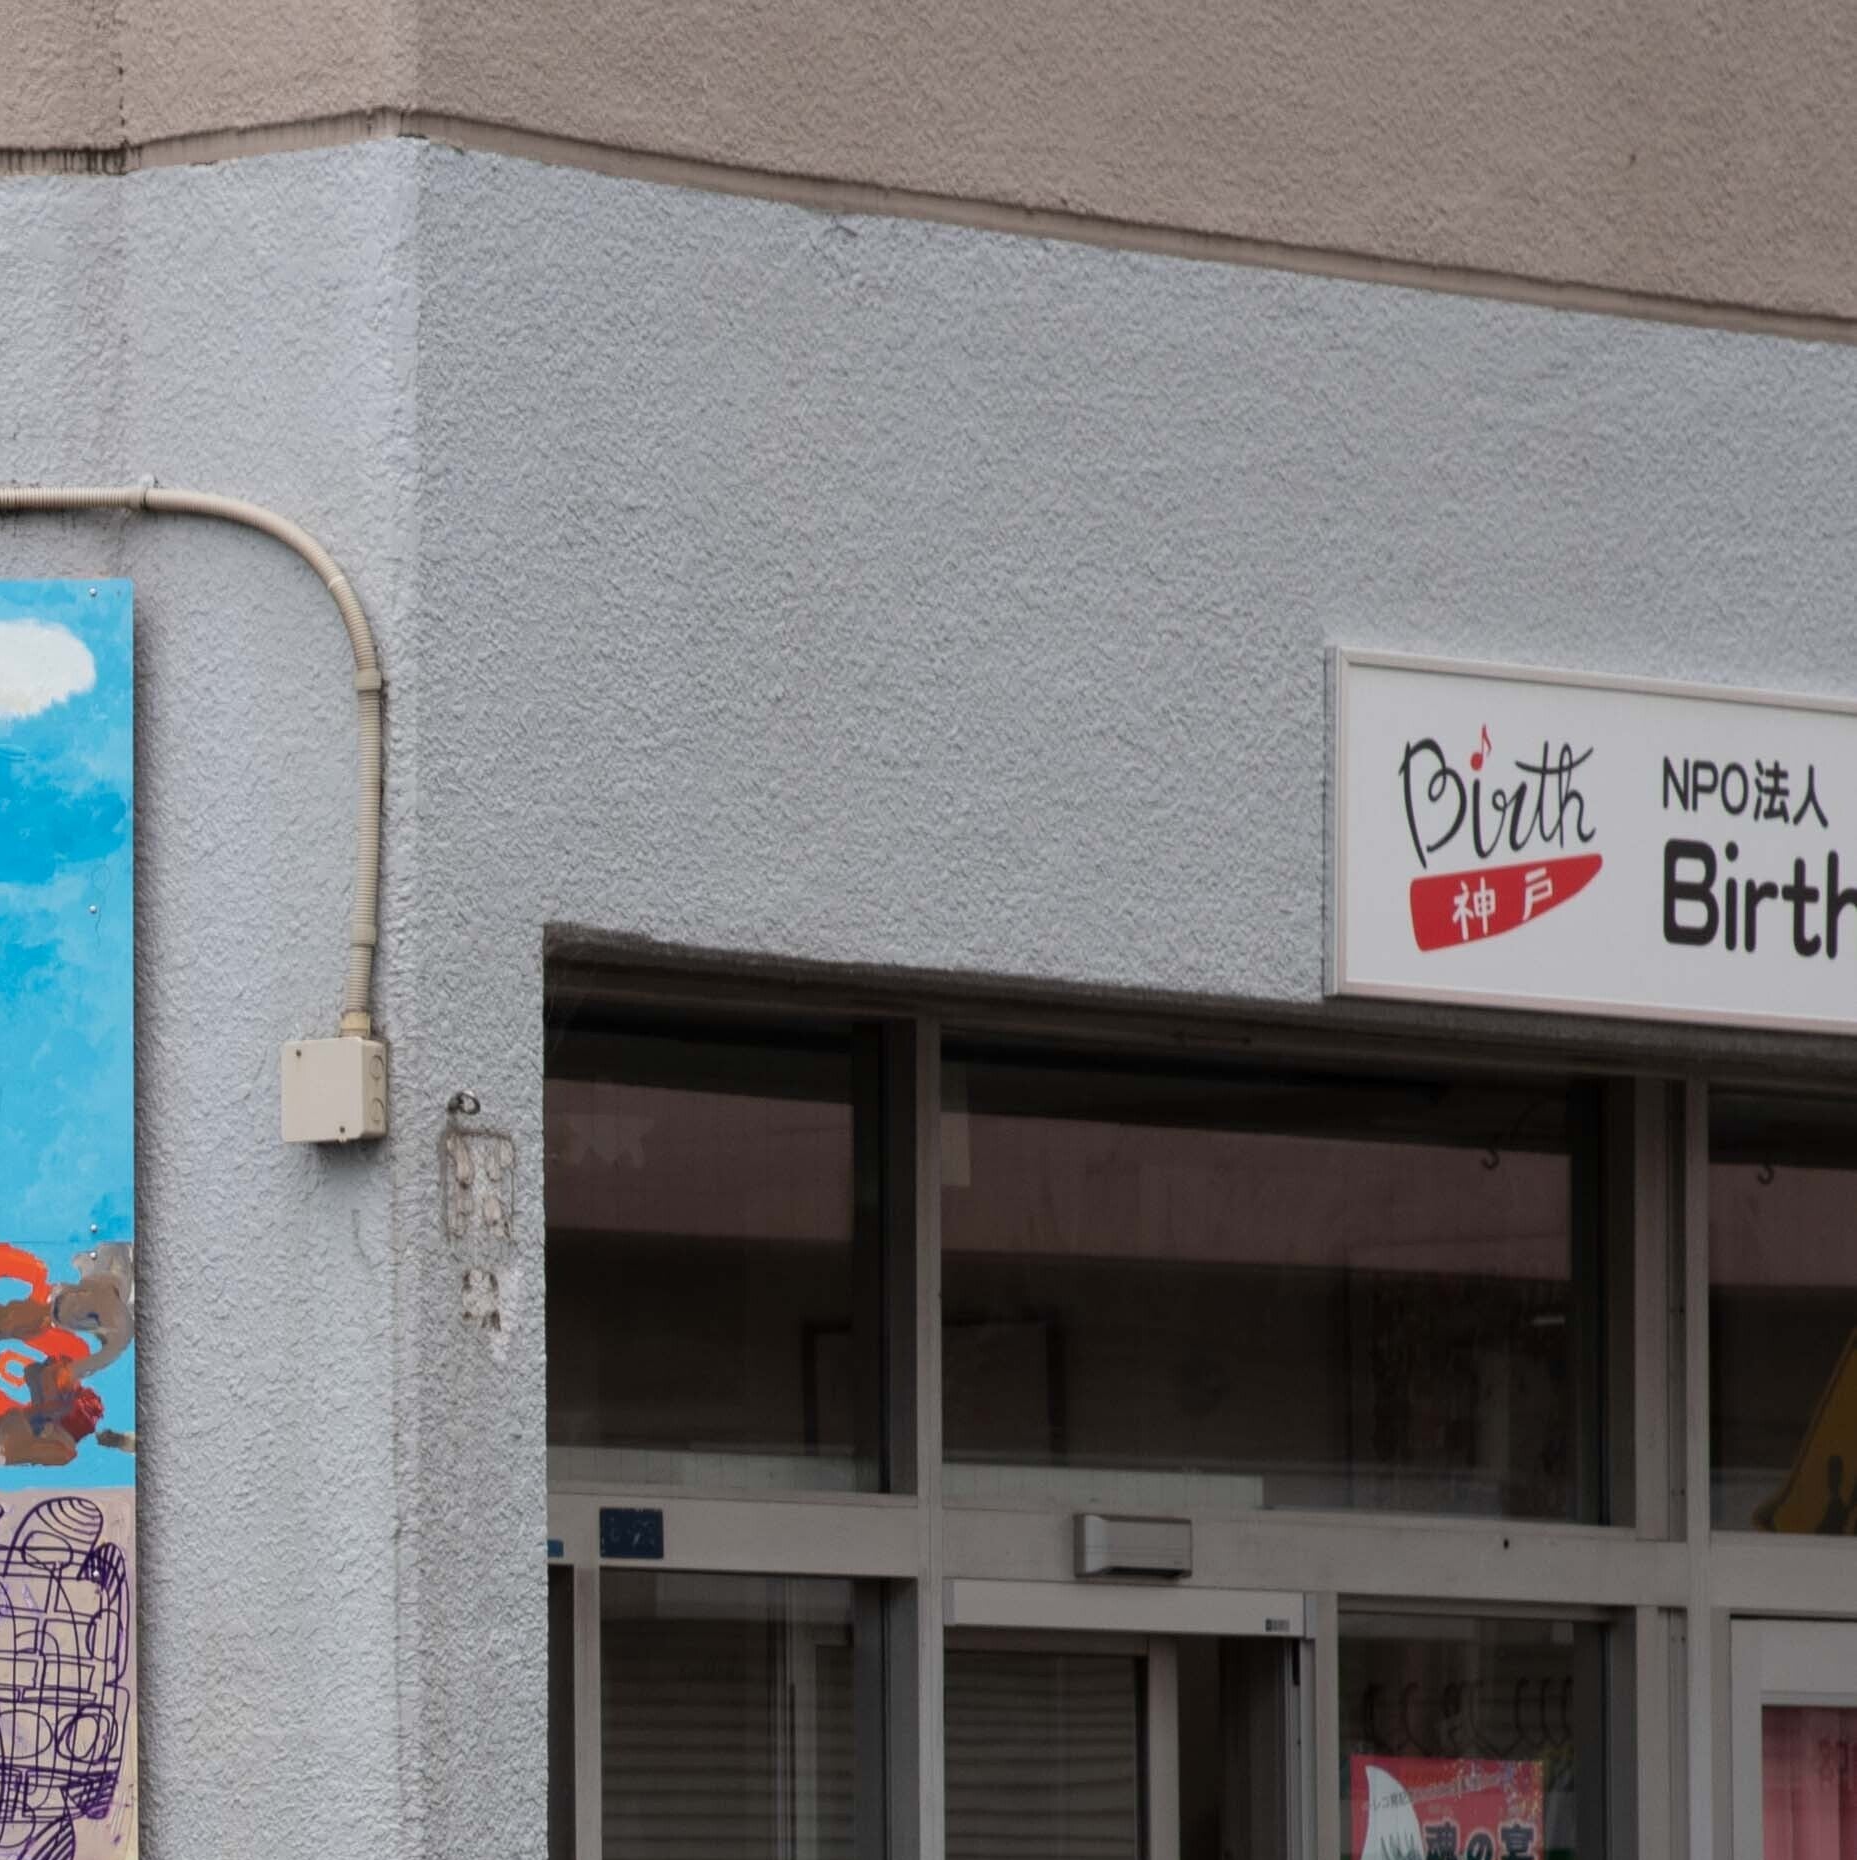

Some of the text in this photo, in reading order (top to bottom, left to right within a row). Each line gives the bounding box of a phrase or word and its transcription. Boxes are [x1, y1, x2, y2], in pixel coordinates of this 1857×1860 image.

[1399, 727, 1597, 868] Birth
[1662, 756, 1830, 829] NPO法人
[1452, 868, 1553, 940] 神戸
